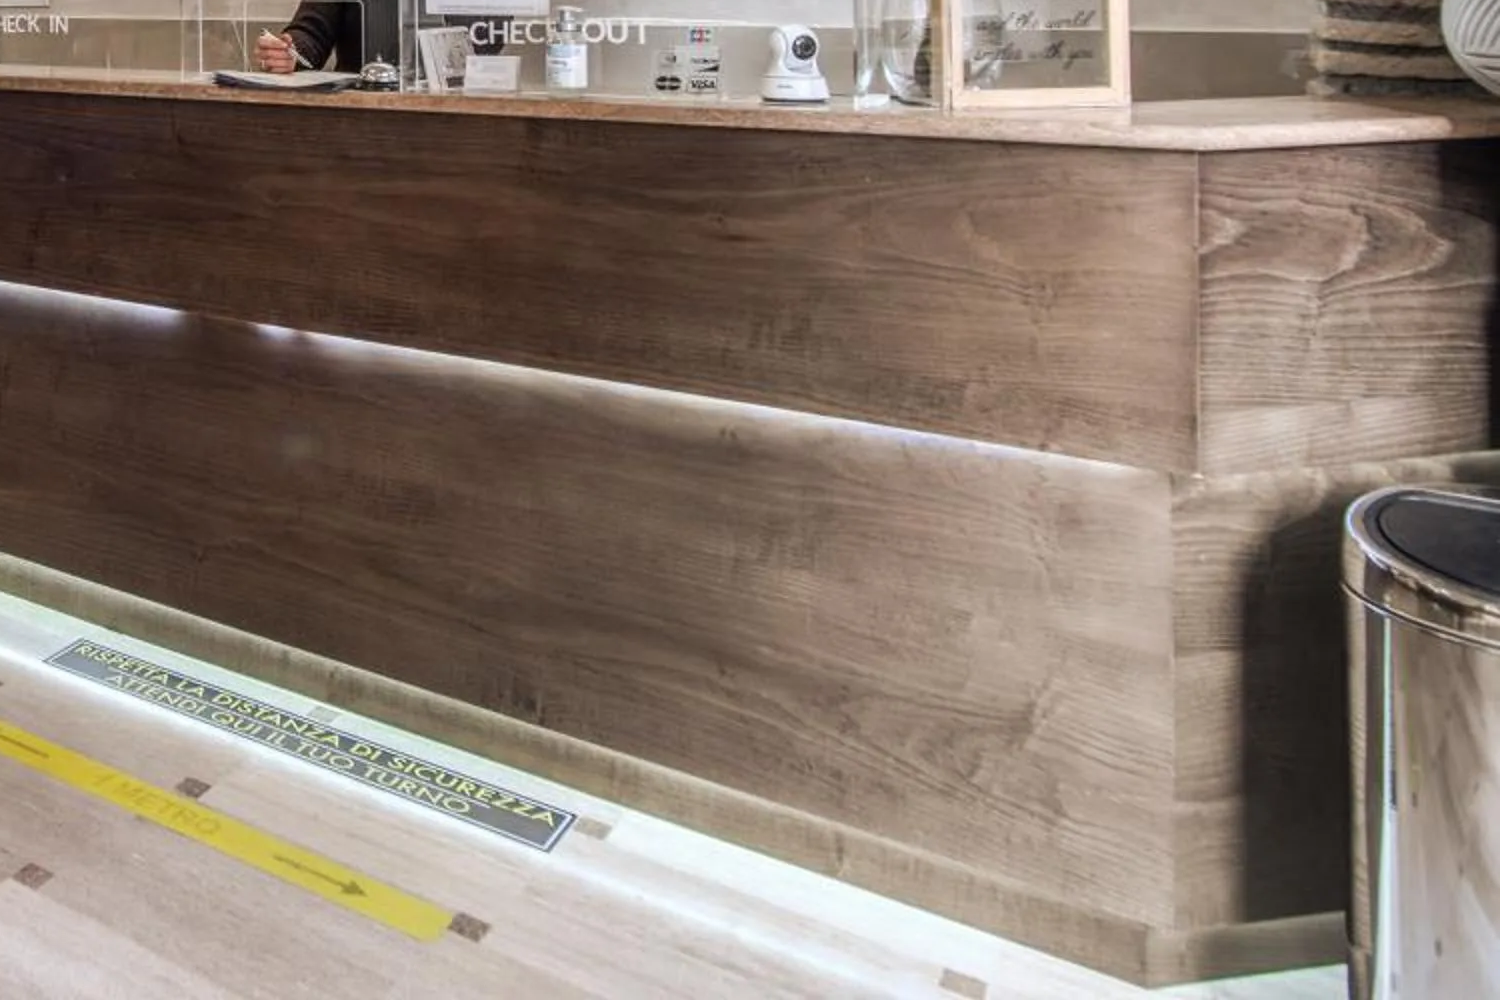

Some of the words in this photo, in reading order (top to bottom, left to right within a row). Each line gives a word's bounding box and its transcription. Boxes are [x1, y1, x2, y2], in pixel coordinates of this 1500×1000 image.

[49, 15, 69, 34] IN
[581, 19, 648, 45] OUT
[76, 644, 169, 686] RISPETTA
[177, 681, 205, 698] LA
[212, 692, 340, 748] DISTANZA
[350, 743, 381, 761] DI
[387, 755, 555, 828] SICUREZZA
[106, 674, 207, 715] ATTENDI
[211, 712, 263, 739] QUI
[267, 732, 288, 747] IL
[296, 740, 355, 770] TUO
[364, 766, 470, 814] TURNO
